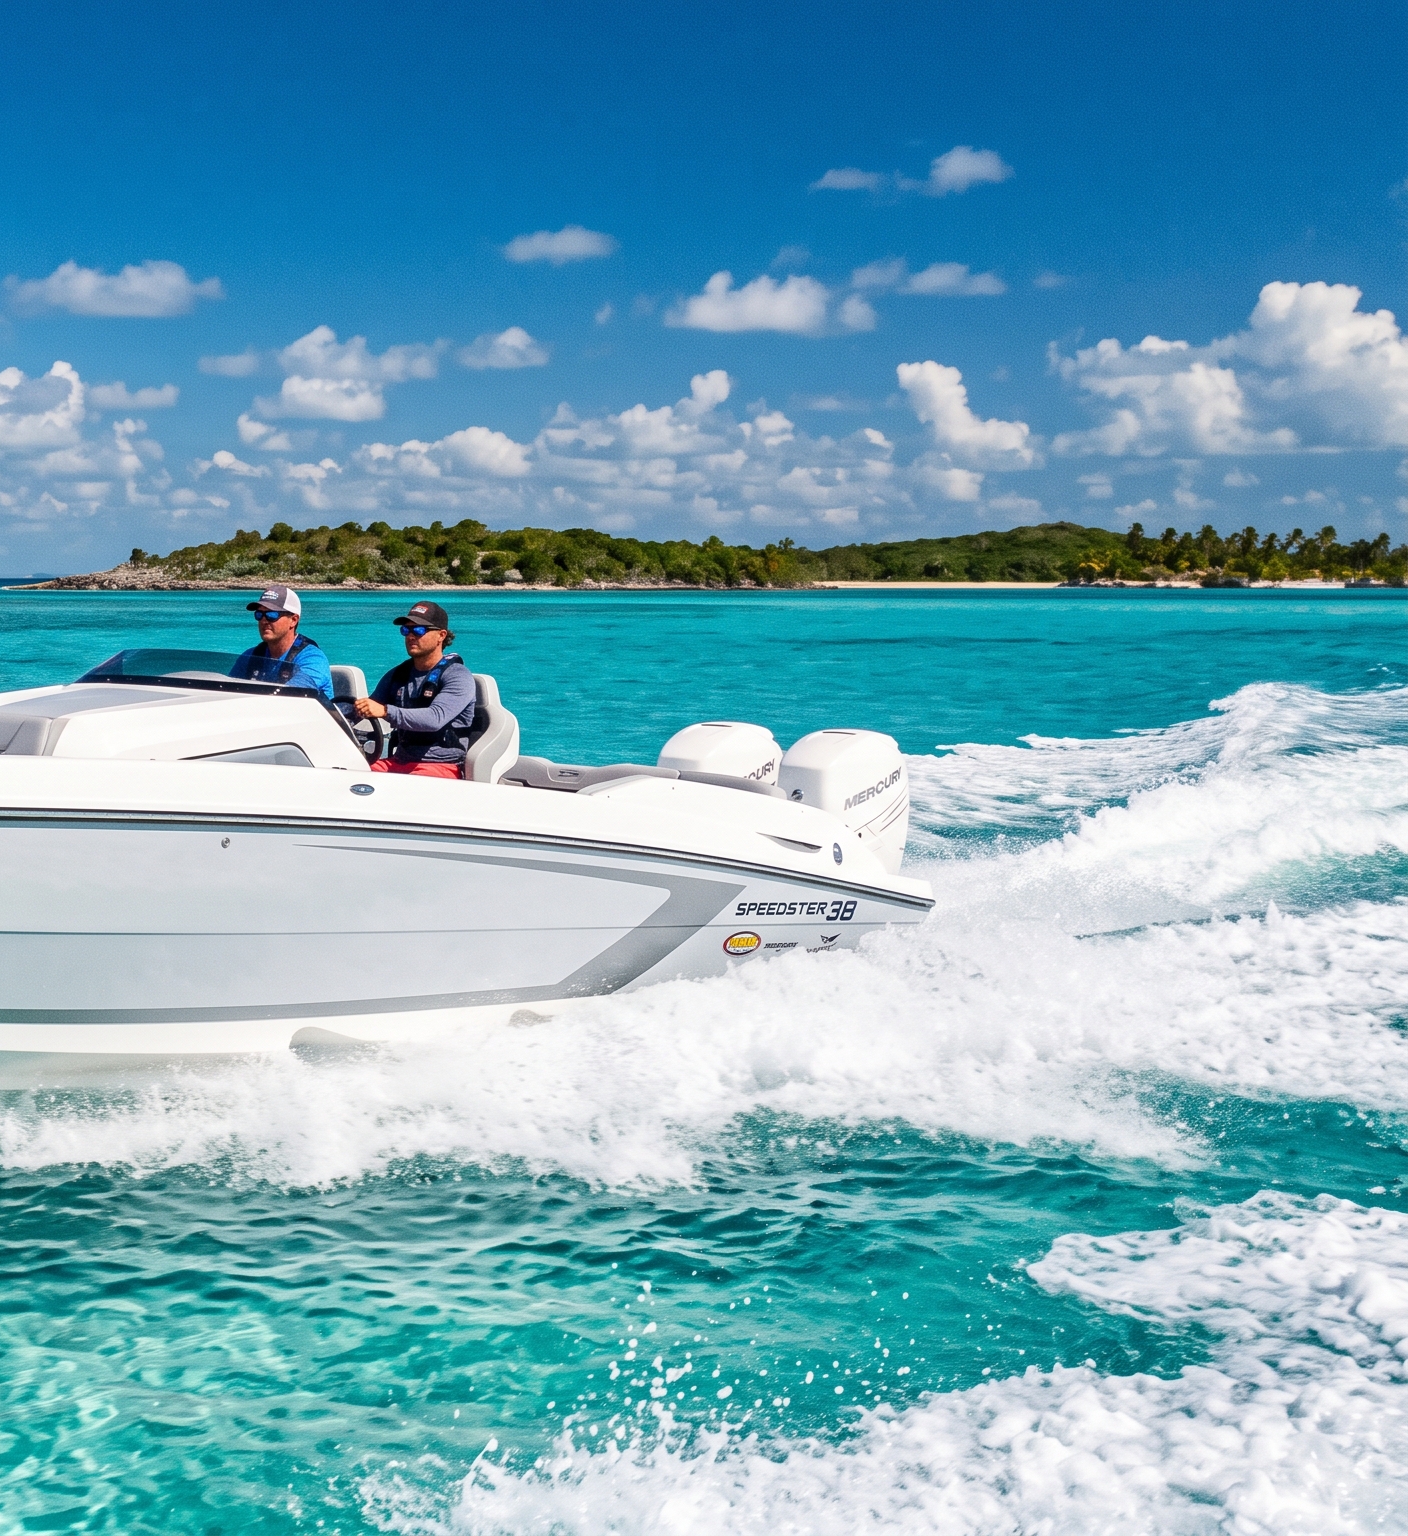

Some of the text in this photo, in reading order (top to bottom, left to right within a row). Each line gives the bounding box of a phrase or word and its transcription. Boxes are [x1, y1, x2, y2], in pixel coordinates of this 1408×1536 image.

[844, 766, 901, 811] MERCURY
[735, 900, 858, 921] SPEEDSTER 38
